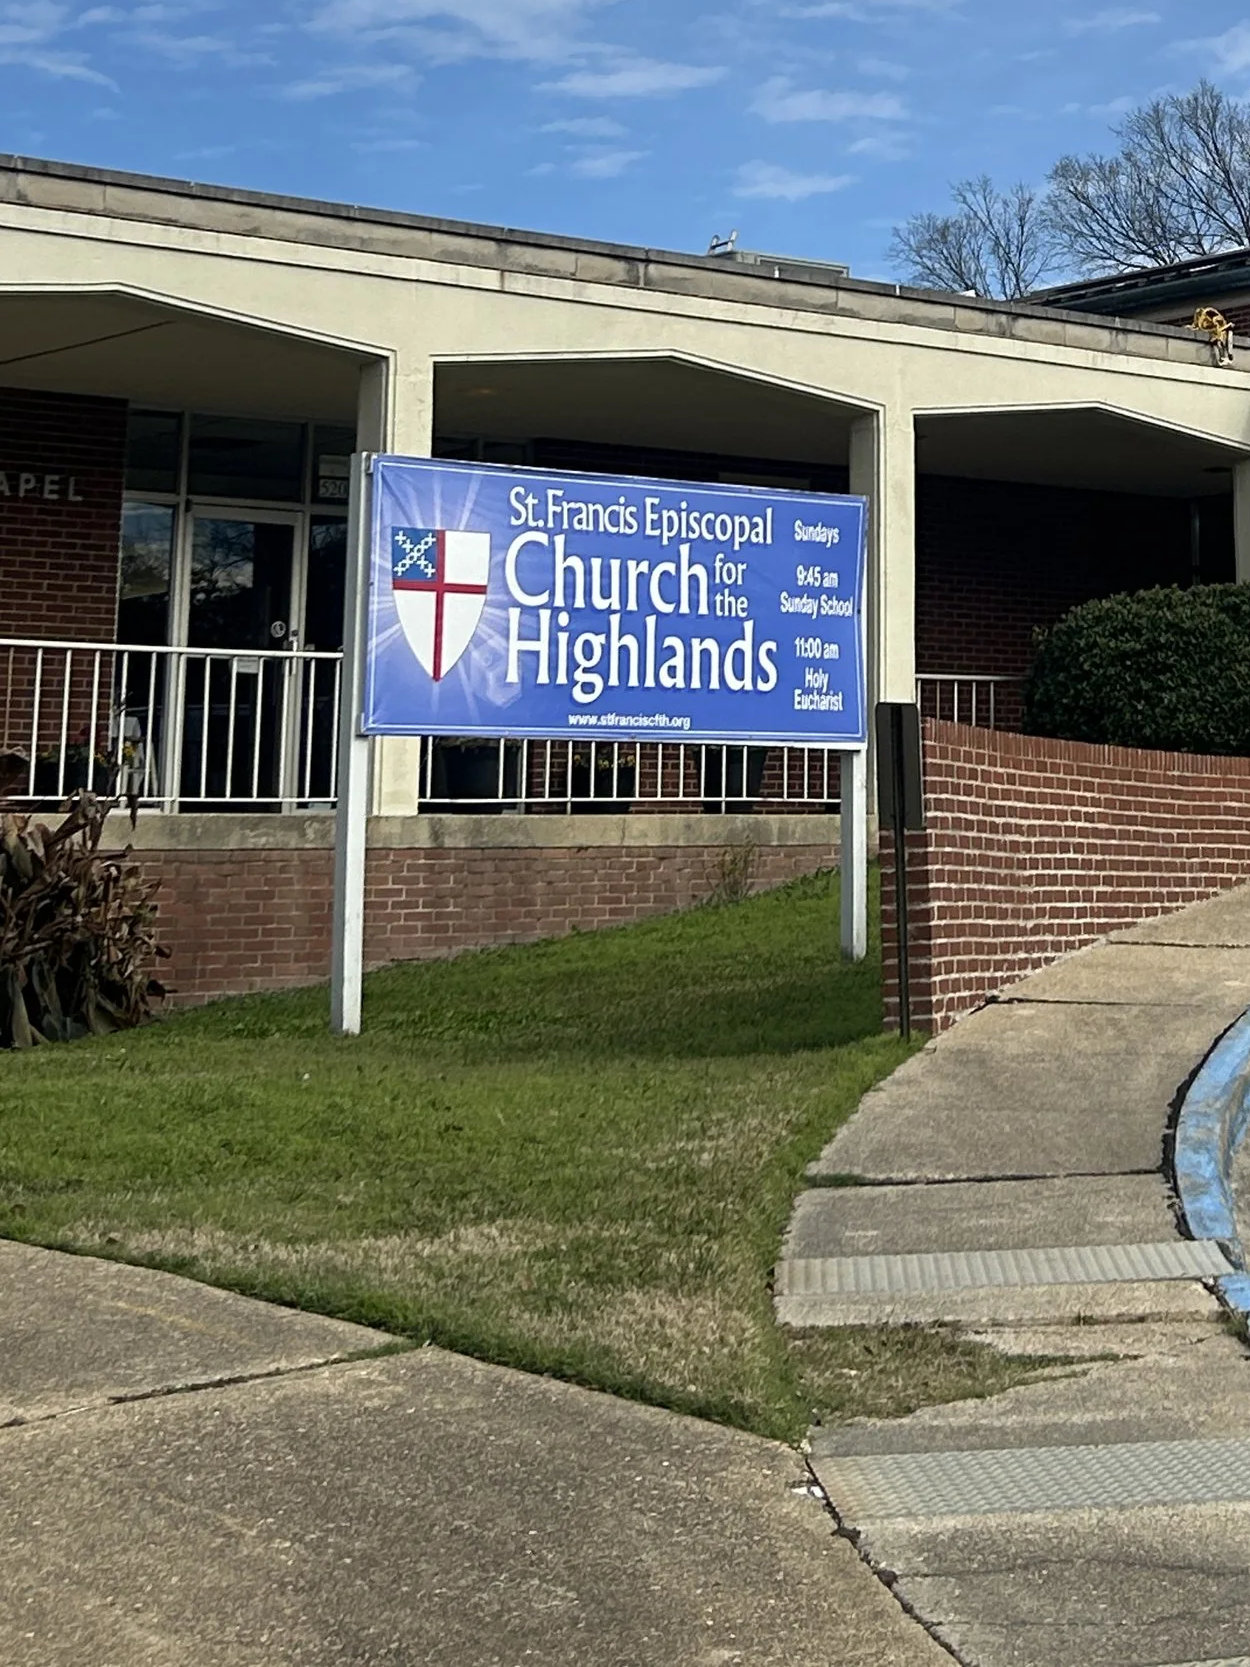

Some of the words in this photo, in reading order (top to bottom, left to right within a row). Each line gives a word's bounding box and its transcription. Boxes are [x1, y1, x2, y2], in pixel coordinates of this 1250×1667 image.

[509, 486, 545, 527] St.
[546, 488, 638, 535] Francis
[644, 497, 773, 551] Episcopal
[794, 519, 840, 548] Sundays
[505, 531, 709, 615] Church
[714, 553, 747, 585] for
[796, 565, 821, 587] 9:45
[822, 572, 839, 588] am
[714, 588, 748, 617] the
[780, 591, 818, 620] Sunday
[820, 594, 854, 617] School
[505, 607, 778, 704] Highlands
[794, 637, 822, 659] 11:00
[823, 643, 839, 660] am
[805, 667, 829, 694] Holy
[794, 689, 844, 711] Eucharist
